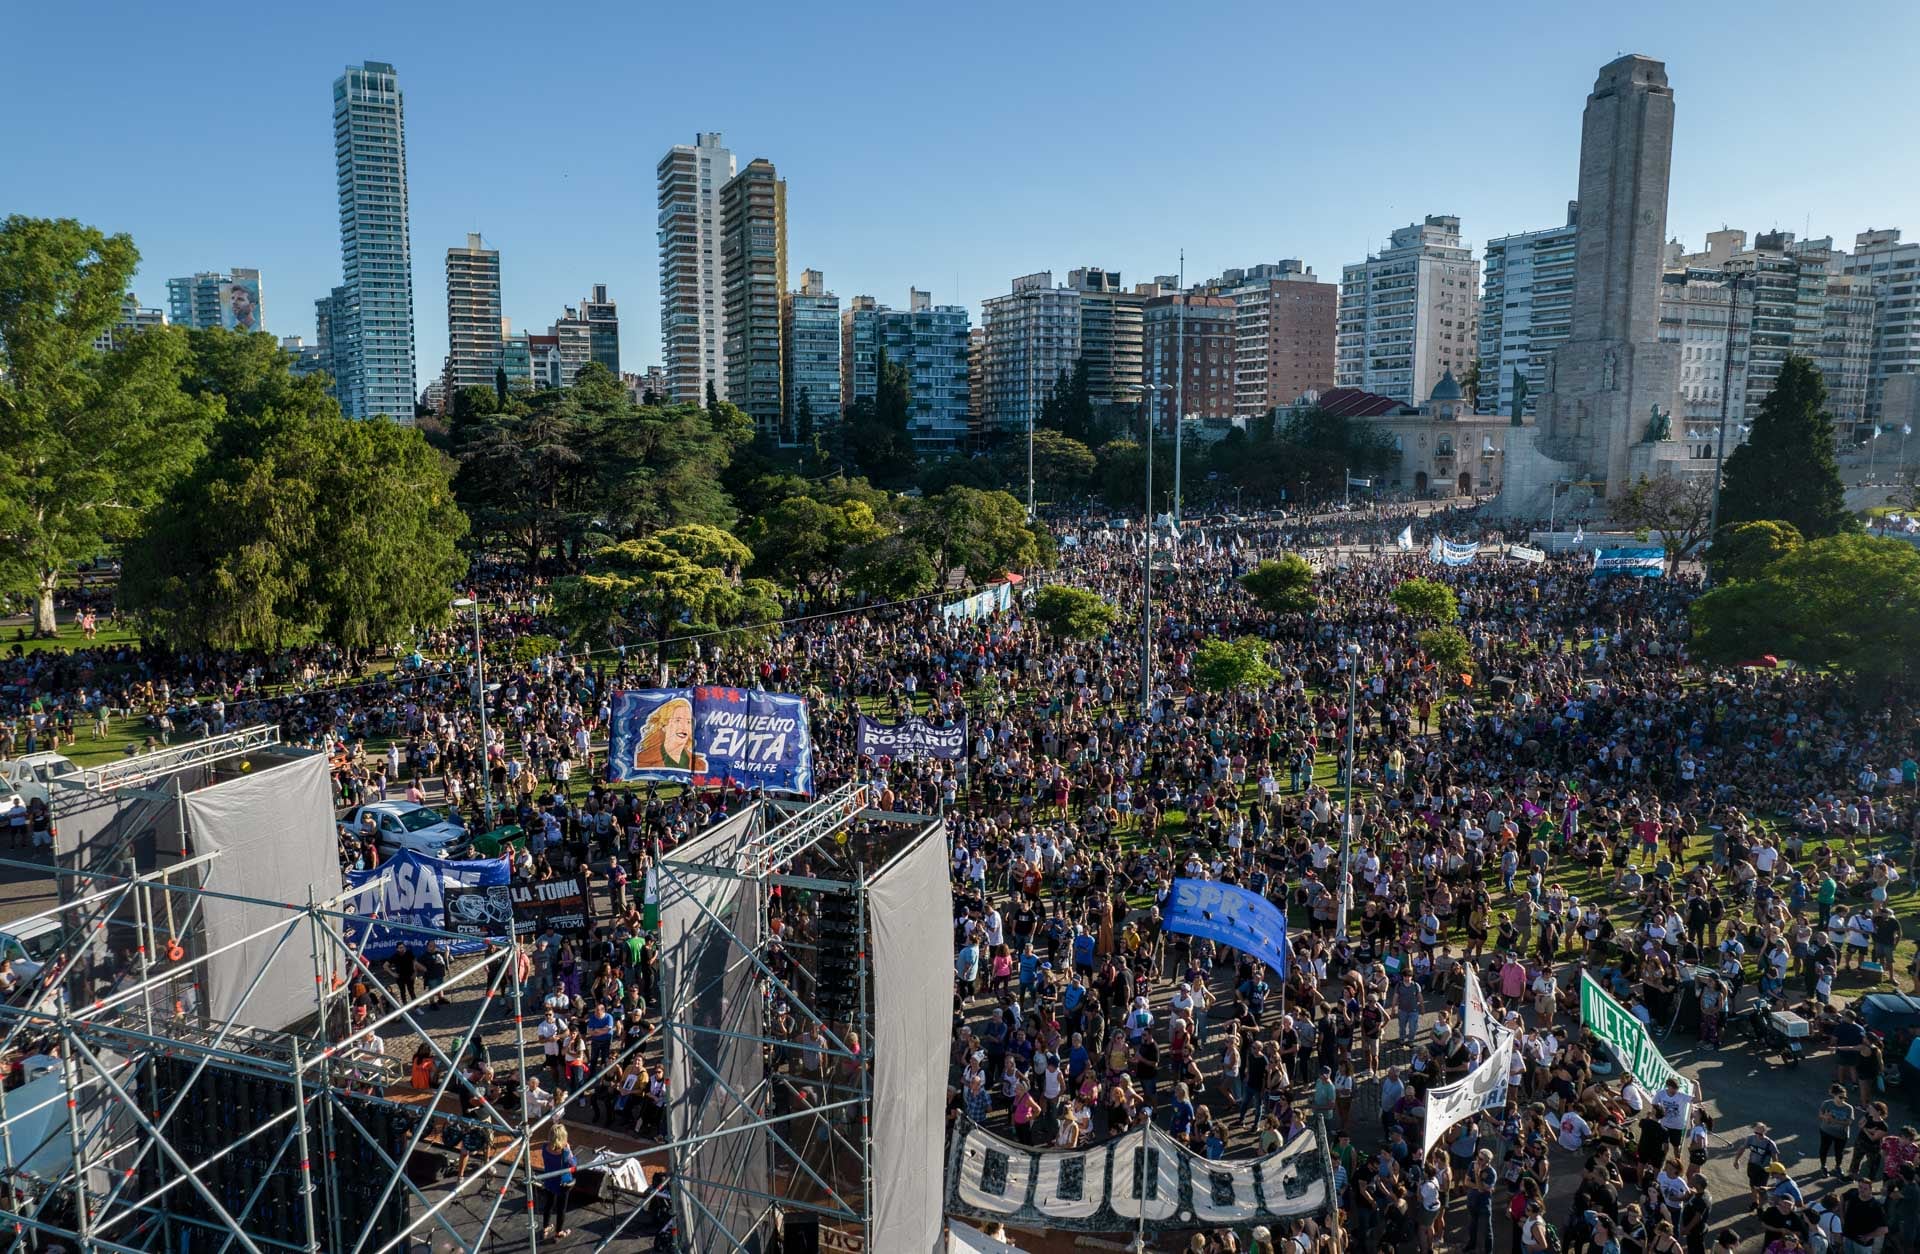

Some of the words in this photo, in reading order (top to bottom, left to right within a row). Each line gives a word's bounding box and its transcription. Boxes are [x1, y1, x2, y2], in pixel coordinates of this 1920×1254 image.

[866, 724, 893, 735] LUZ
[910, 723, 962, 736] FUERZA
[709, 727, 786, 761] EVITA
[864, 732, 963, 747] ROSARIO
[763, 763, 777, 773] FE
[511, 886, 532, 903] LA
[536, 879, 580, 901] TOMA
